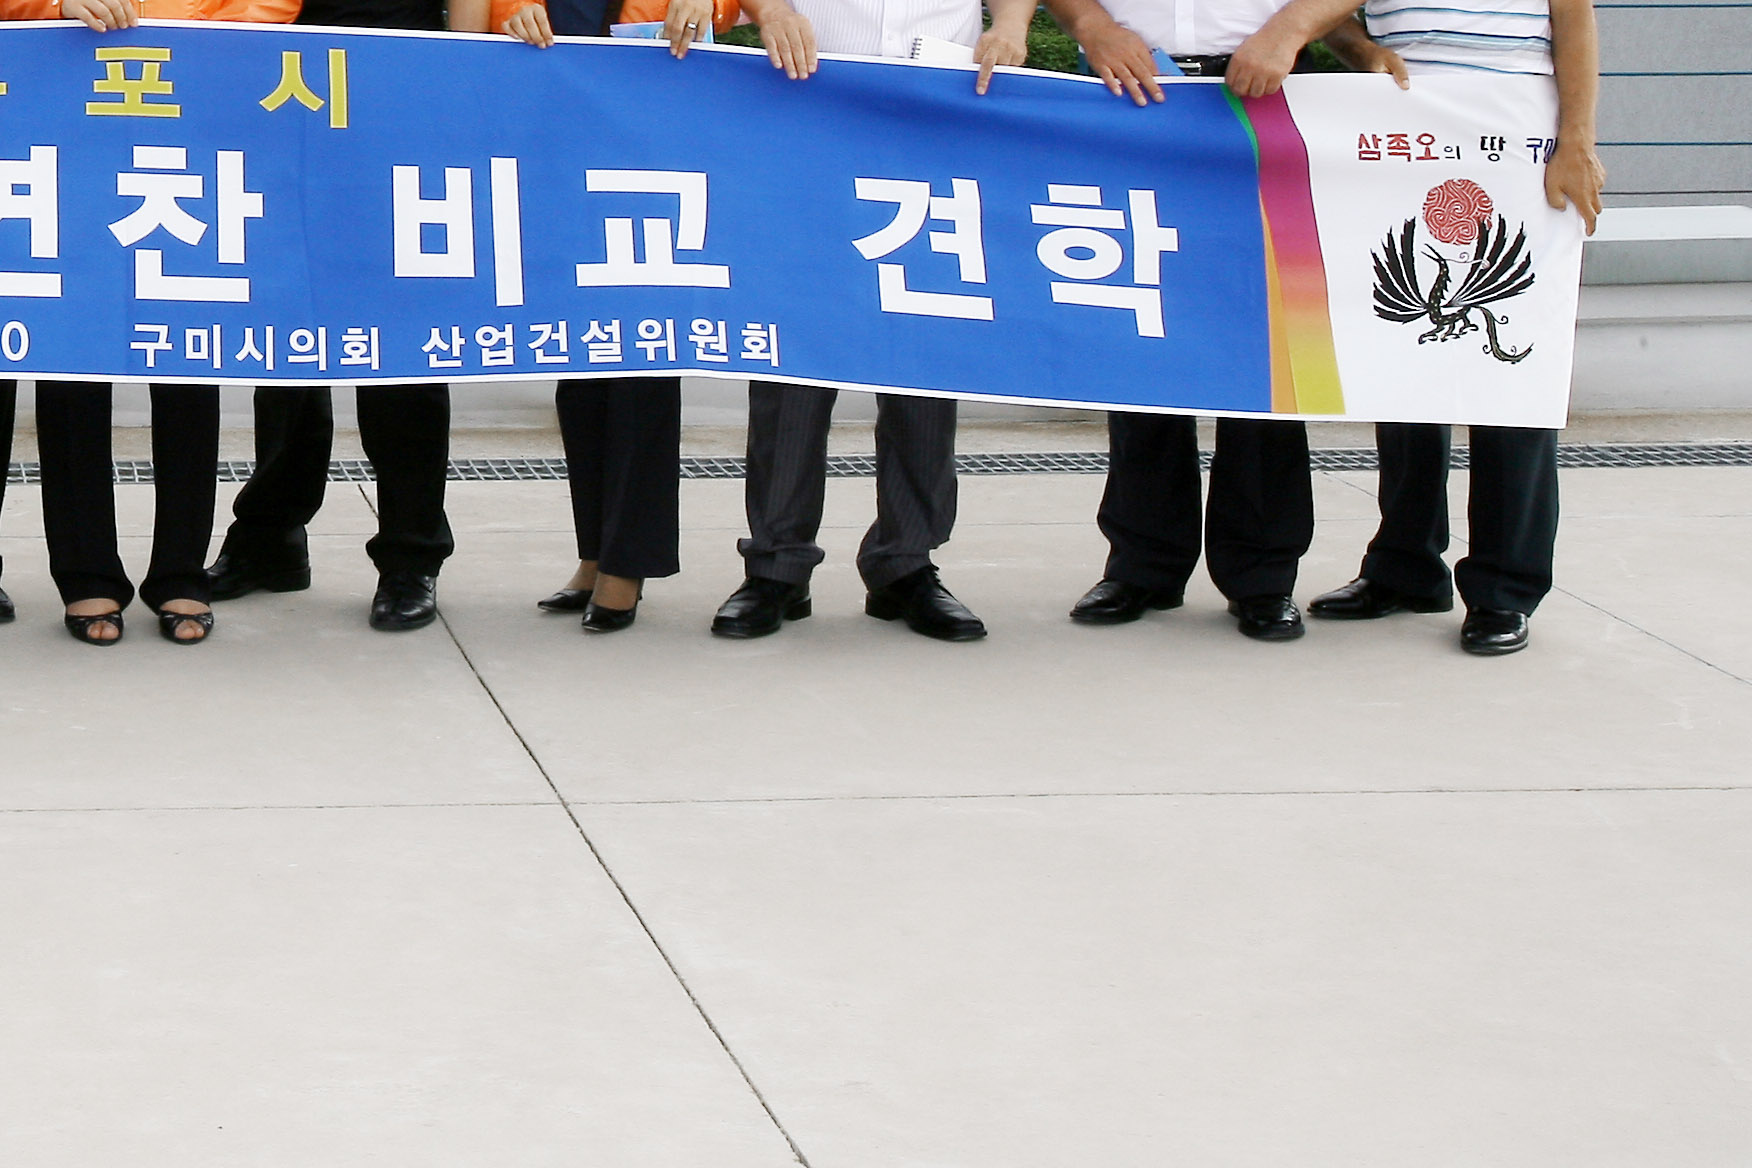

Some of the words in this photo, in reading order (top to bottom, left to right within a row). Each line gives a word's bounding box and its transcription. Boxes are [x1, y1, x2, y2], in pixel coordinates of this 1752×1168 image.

[1358, 132, 1461, 163] 삼족오의
[1479, 135, 1507, 162] 땅
[391, 156, 732, 307] 비교
[850, 176, 1179, 339] 견학
[129, 322, 381, 371] 구미시의회
[421, 318, 780, 368] 산업건설위원회
